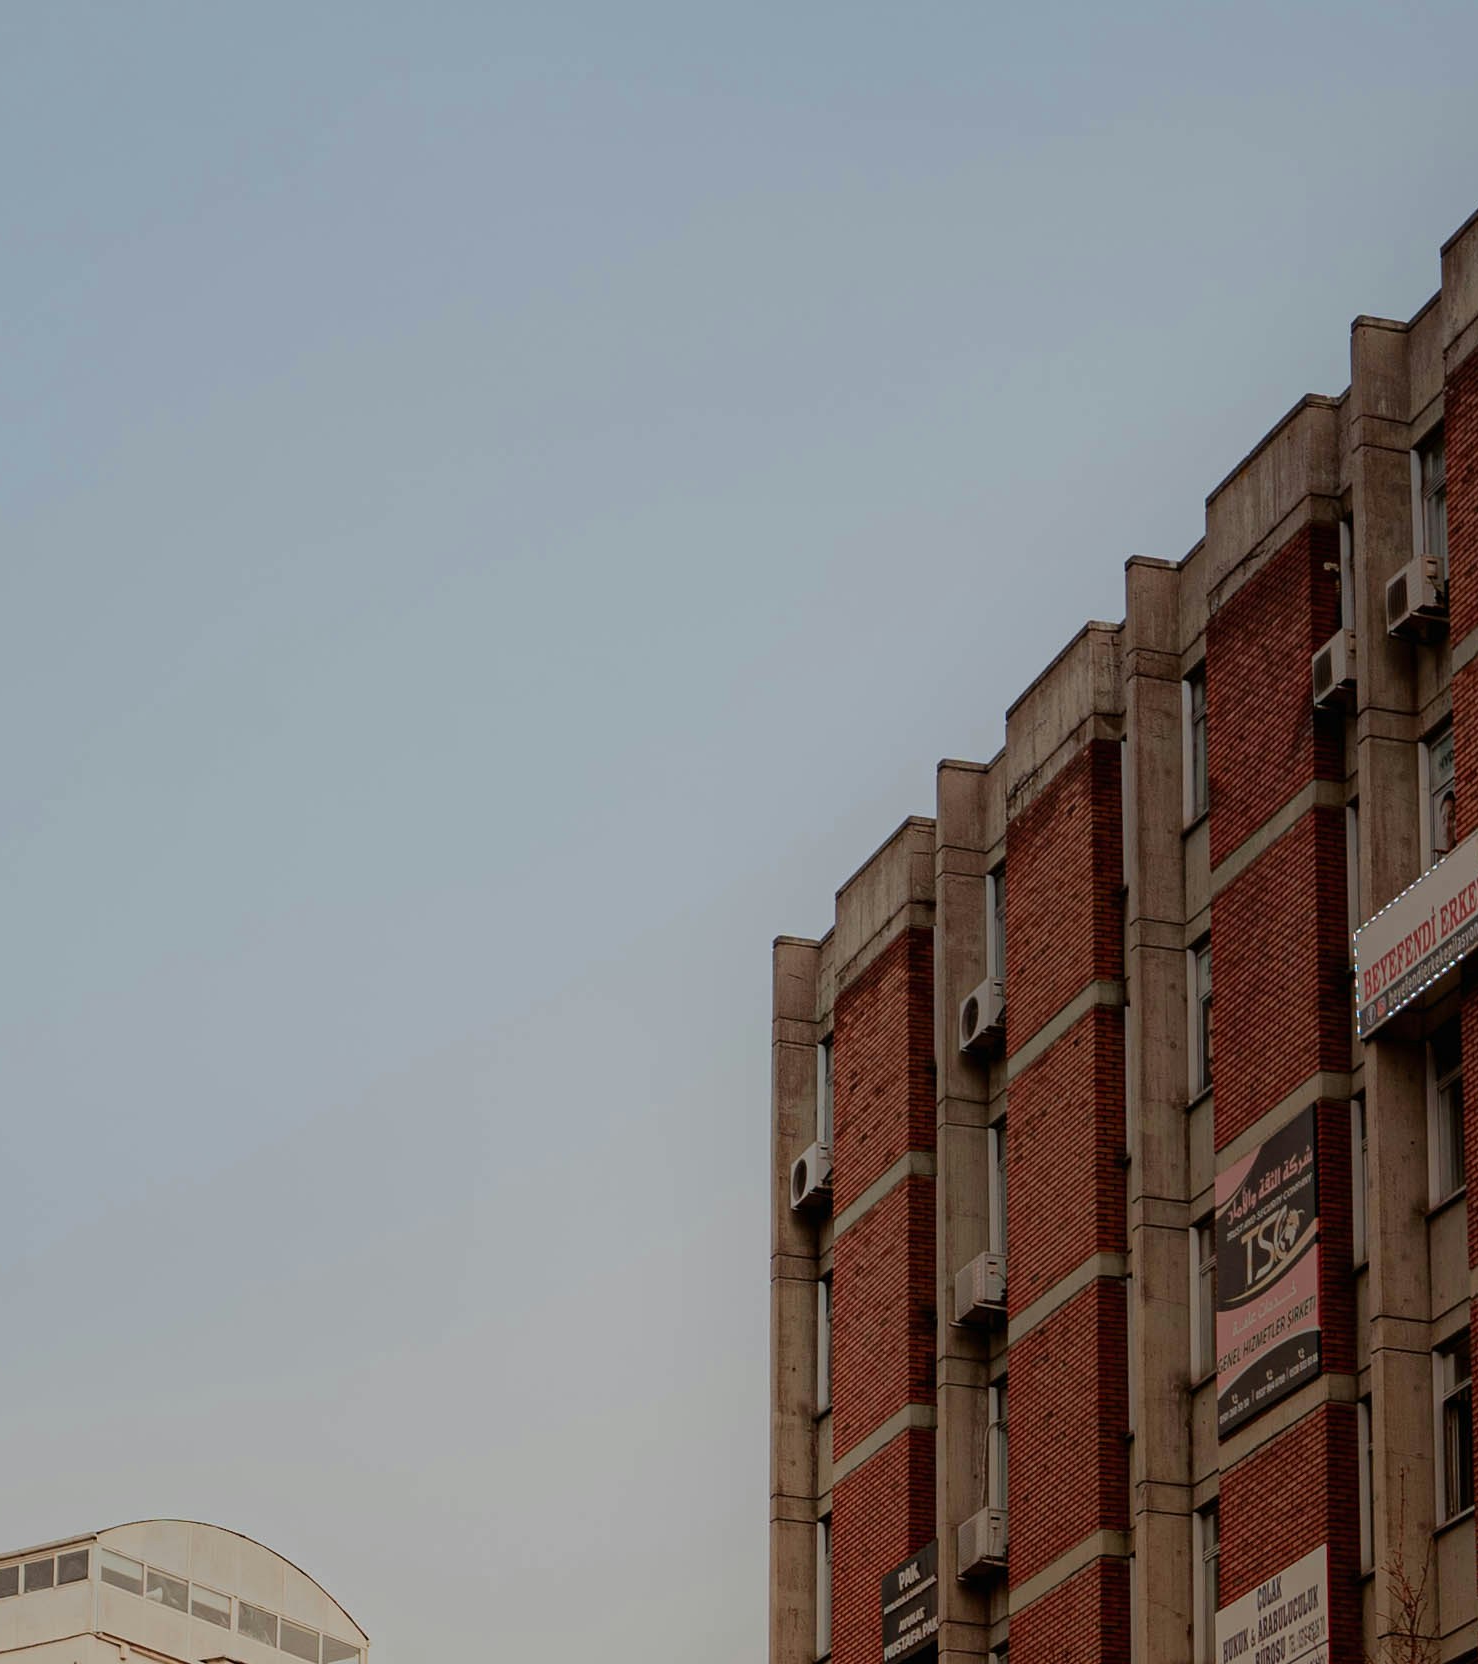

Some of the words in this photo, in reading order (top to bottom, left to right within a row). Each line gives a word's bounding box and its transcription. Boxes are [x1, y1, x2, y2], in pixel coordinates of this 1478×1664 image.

[1362, 905, 1438, 1002] BEYEFENDİ
[1222, 1626, 1249, 1664] HUKUK
[1257, 1583, 1320, 1645] ARABULUCULUK
